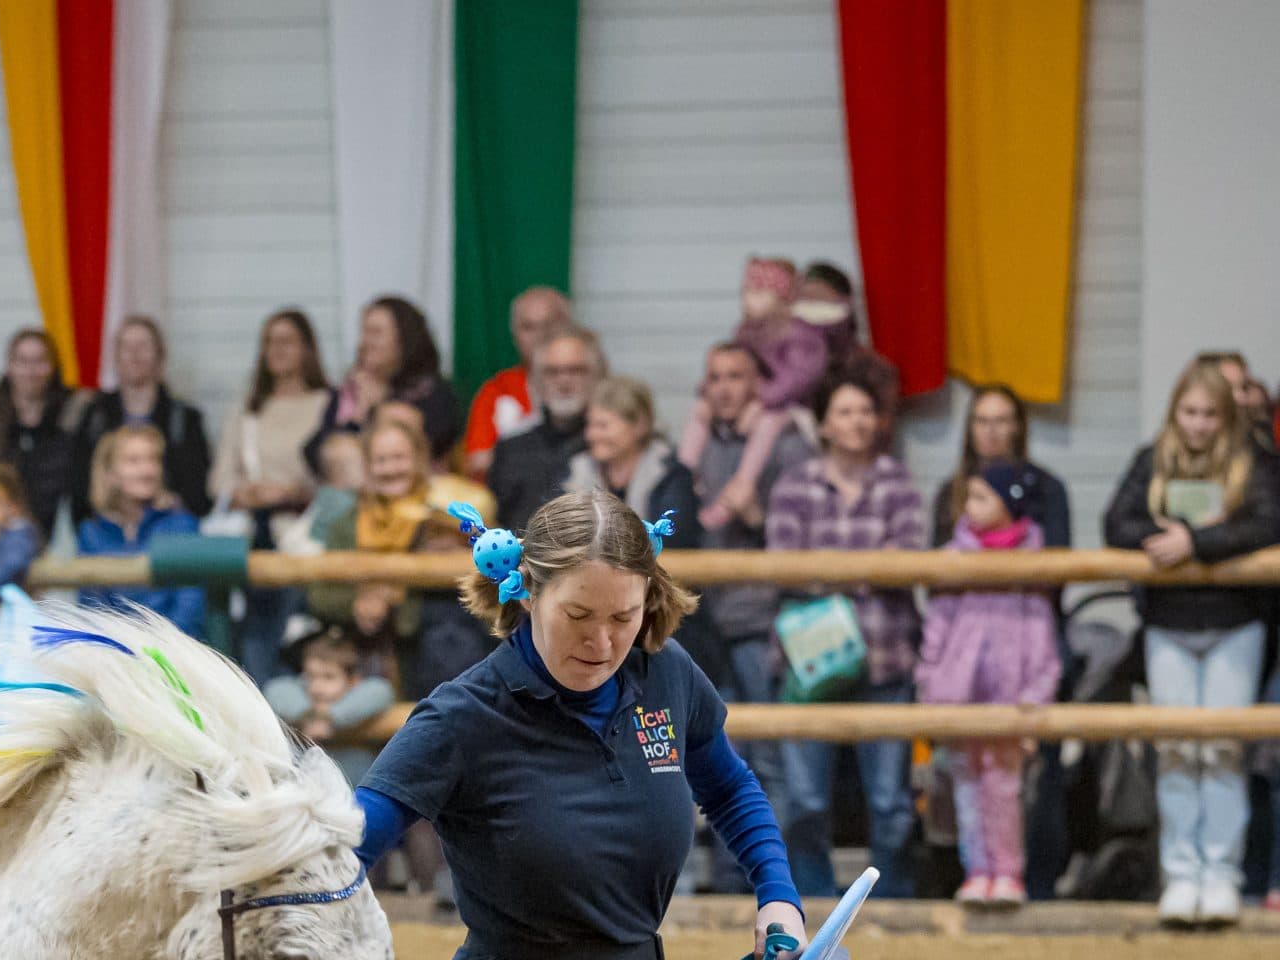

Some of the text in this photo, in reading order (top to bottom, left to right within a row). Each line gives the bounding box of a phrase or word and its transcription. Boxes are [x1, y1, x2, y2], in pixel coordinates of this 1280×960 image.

[633, 707, 672, 730] LICHT
[636, 724, 676, 744] BLICK
[642, 742, 671, 759] HOF
